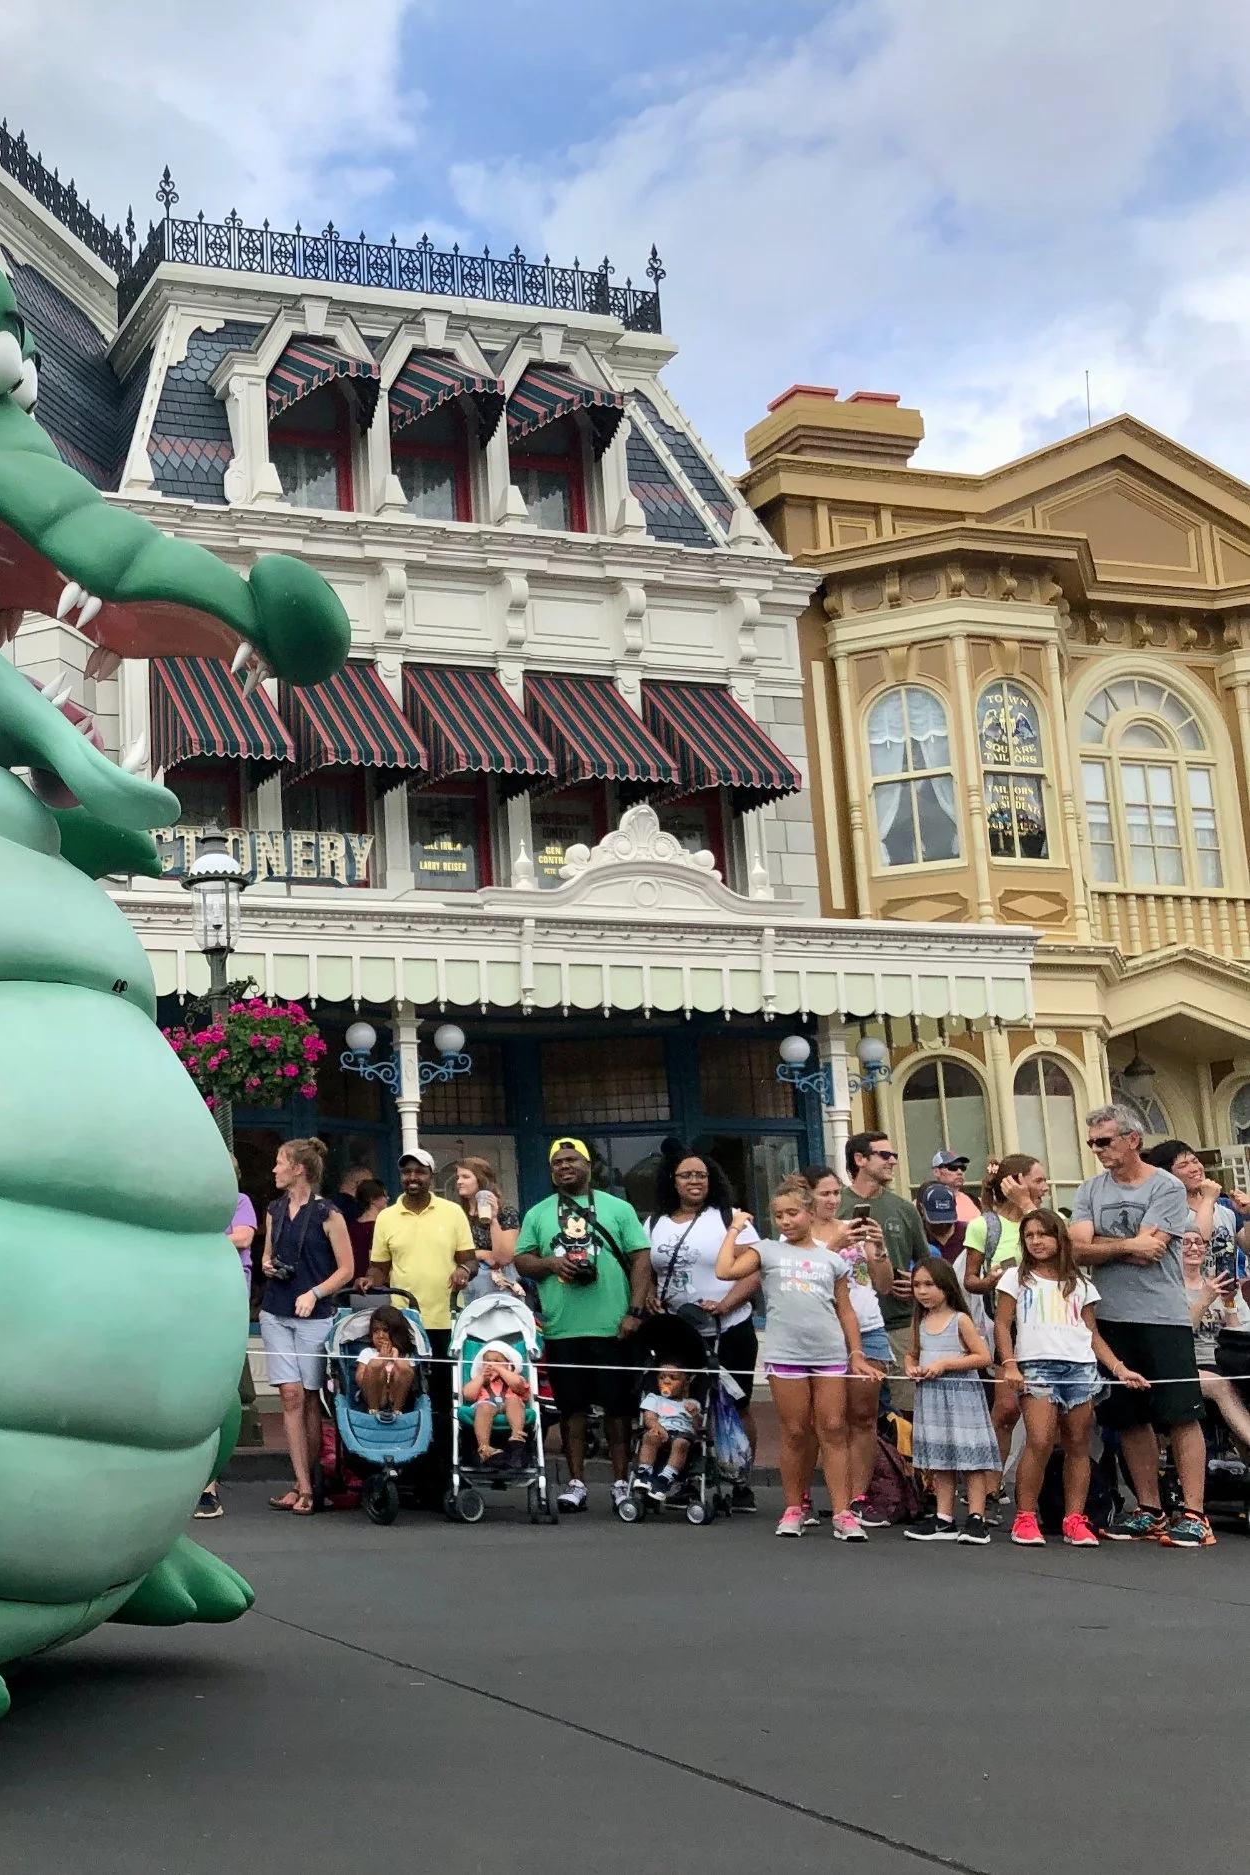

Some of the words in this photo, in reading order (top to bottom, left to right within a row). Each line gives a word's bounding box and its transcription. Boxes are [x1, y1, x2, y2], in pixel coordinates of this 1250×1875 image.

[985, 694, 1029, 708] TOWN
[985, 740, 1036, 754] SQUARE
[984, 752, 1037, 764] TAILORS
[987, 785, 1034, 796] TAILORS
[148, 825, 375, 886] CTONERY
[419, 860, 440, 871] LARRY
[442, 861, 468, 872] REISER
[780, 1268, 792, 1278] BE
[780, 1282, 792, 1292] BE
